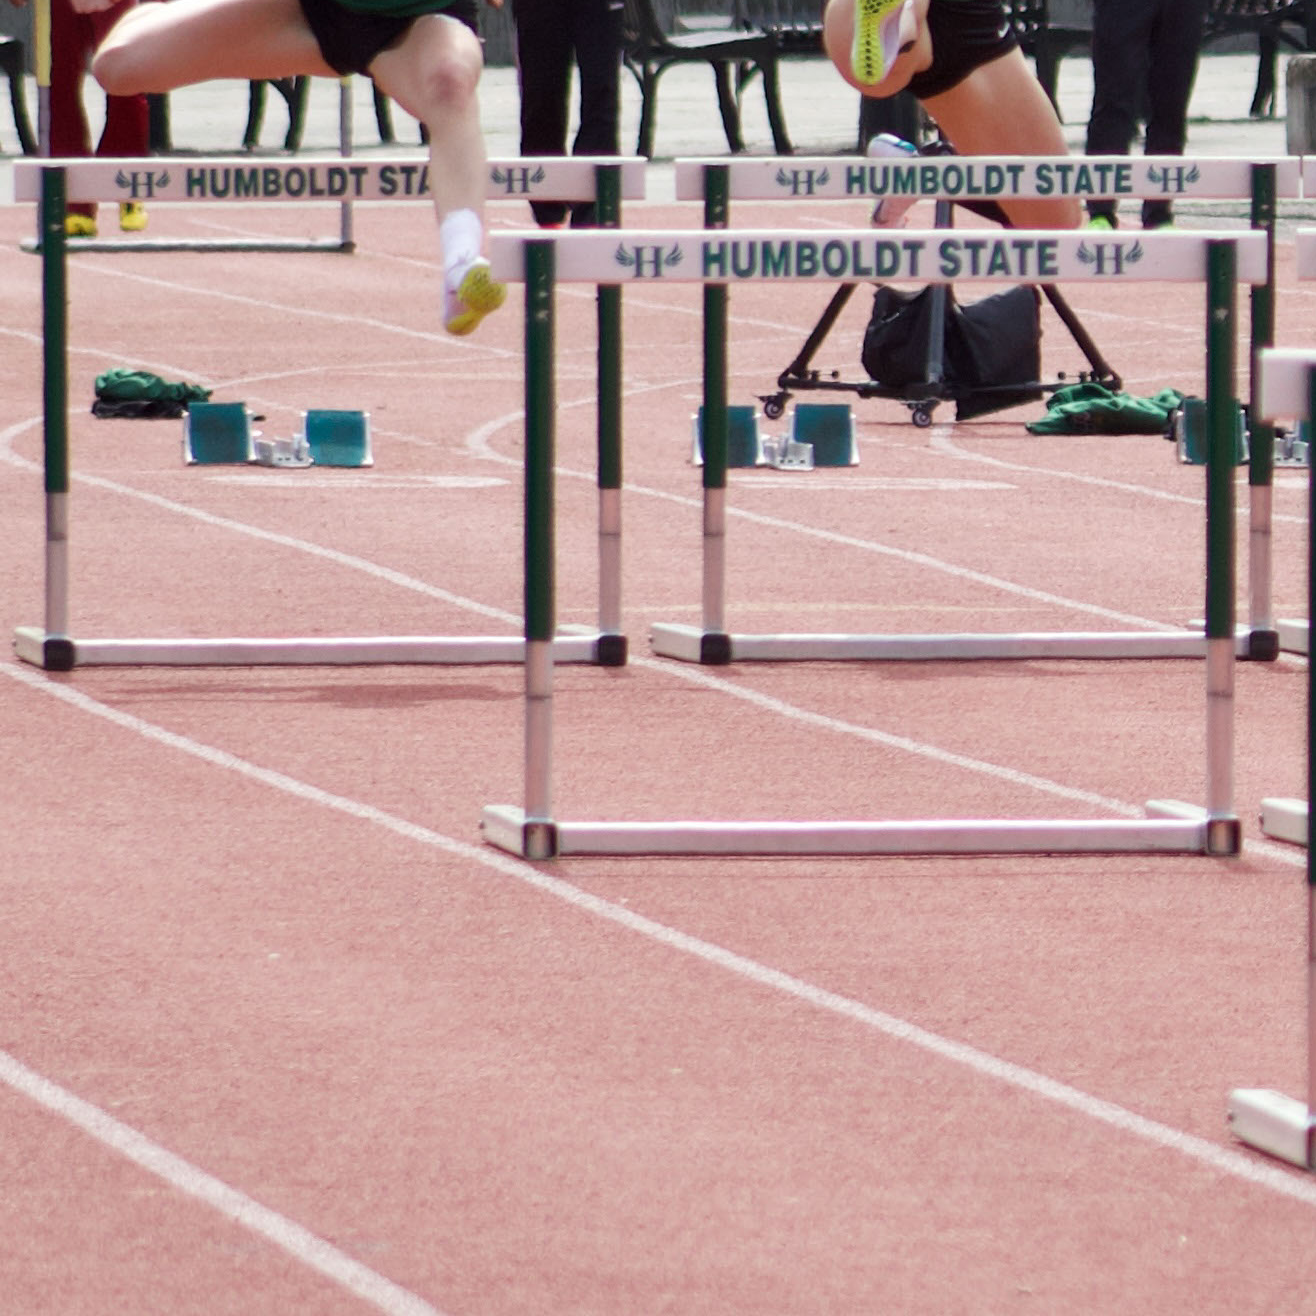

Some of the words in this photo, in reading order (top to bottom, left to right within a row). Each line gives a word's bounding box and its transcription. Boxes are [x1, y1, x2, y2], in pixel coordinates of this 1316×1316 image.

[186, 166, 368, 199] HUMBOLDT
[846, 164, 1025, 196] HUMBOLDT
[1035, 163, 1133, 196] STATE
[702, 239, 924, 279] HUMBOLDT
[938, 239, 1058, 278] STATE
